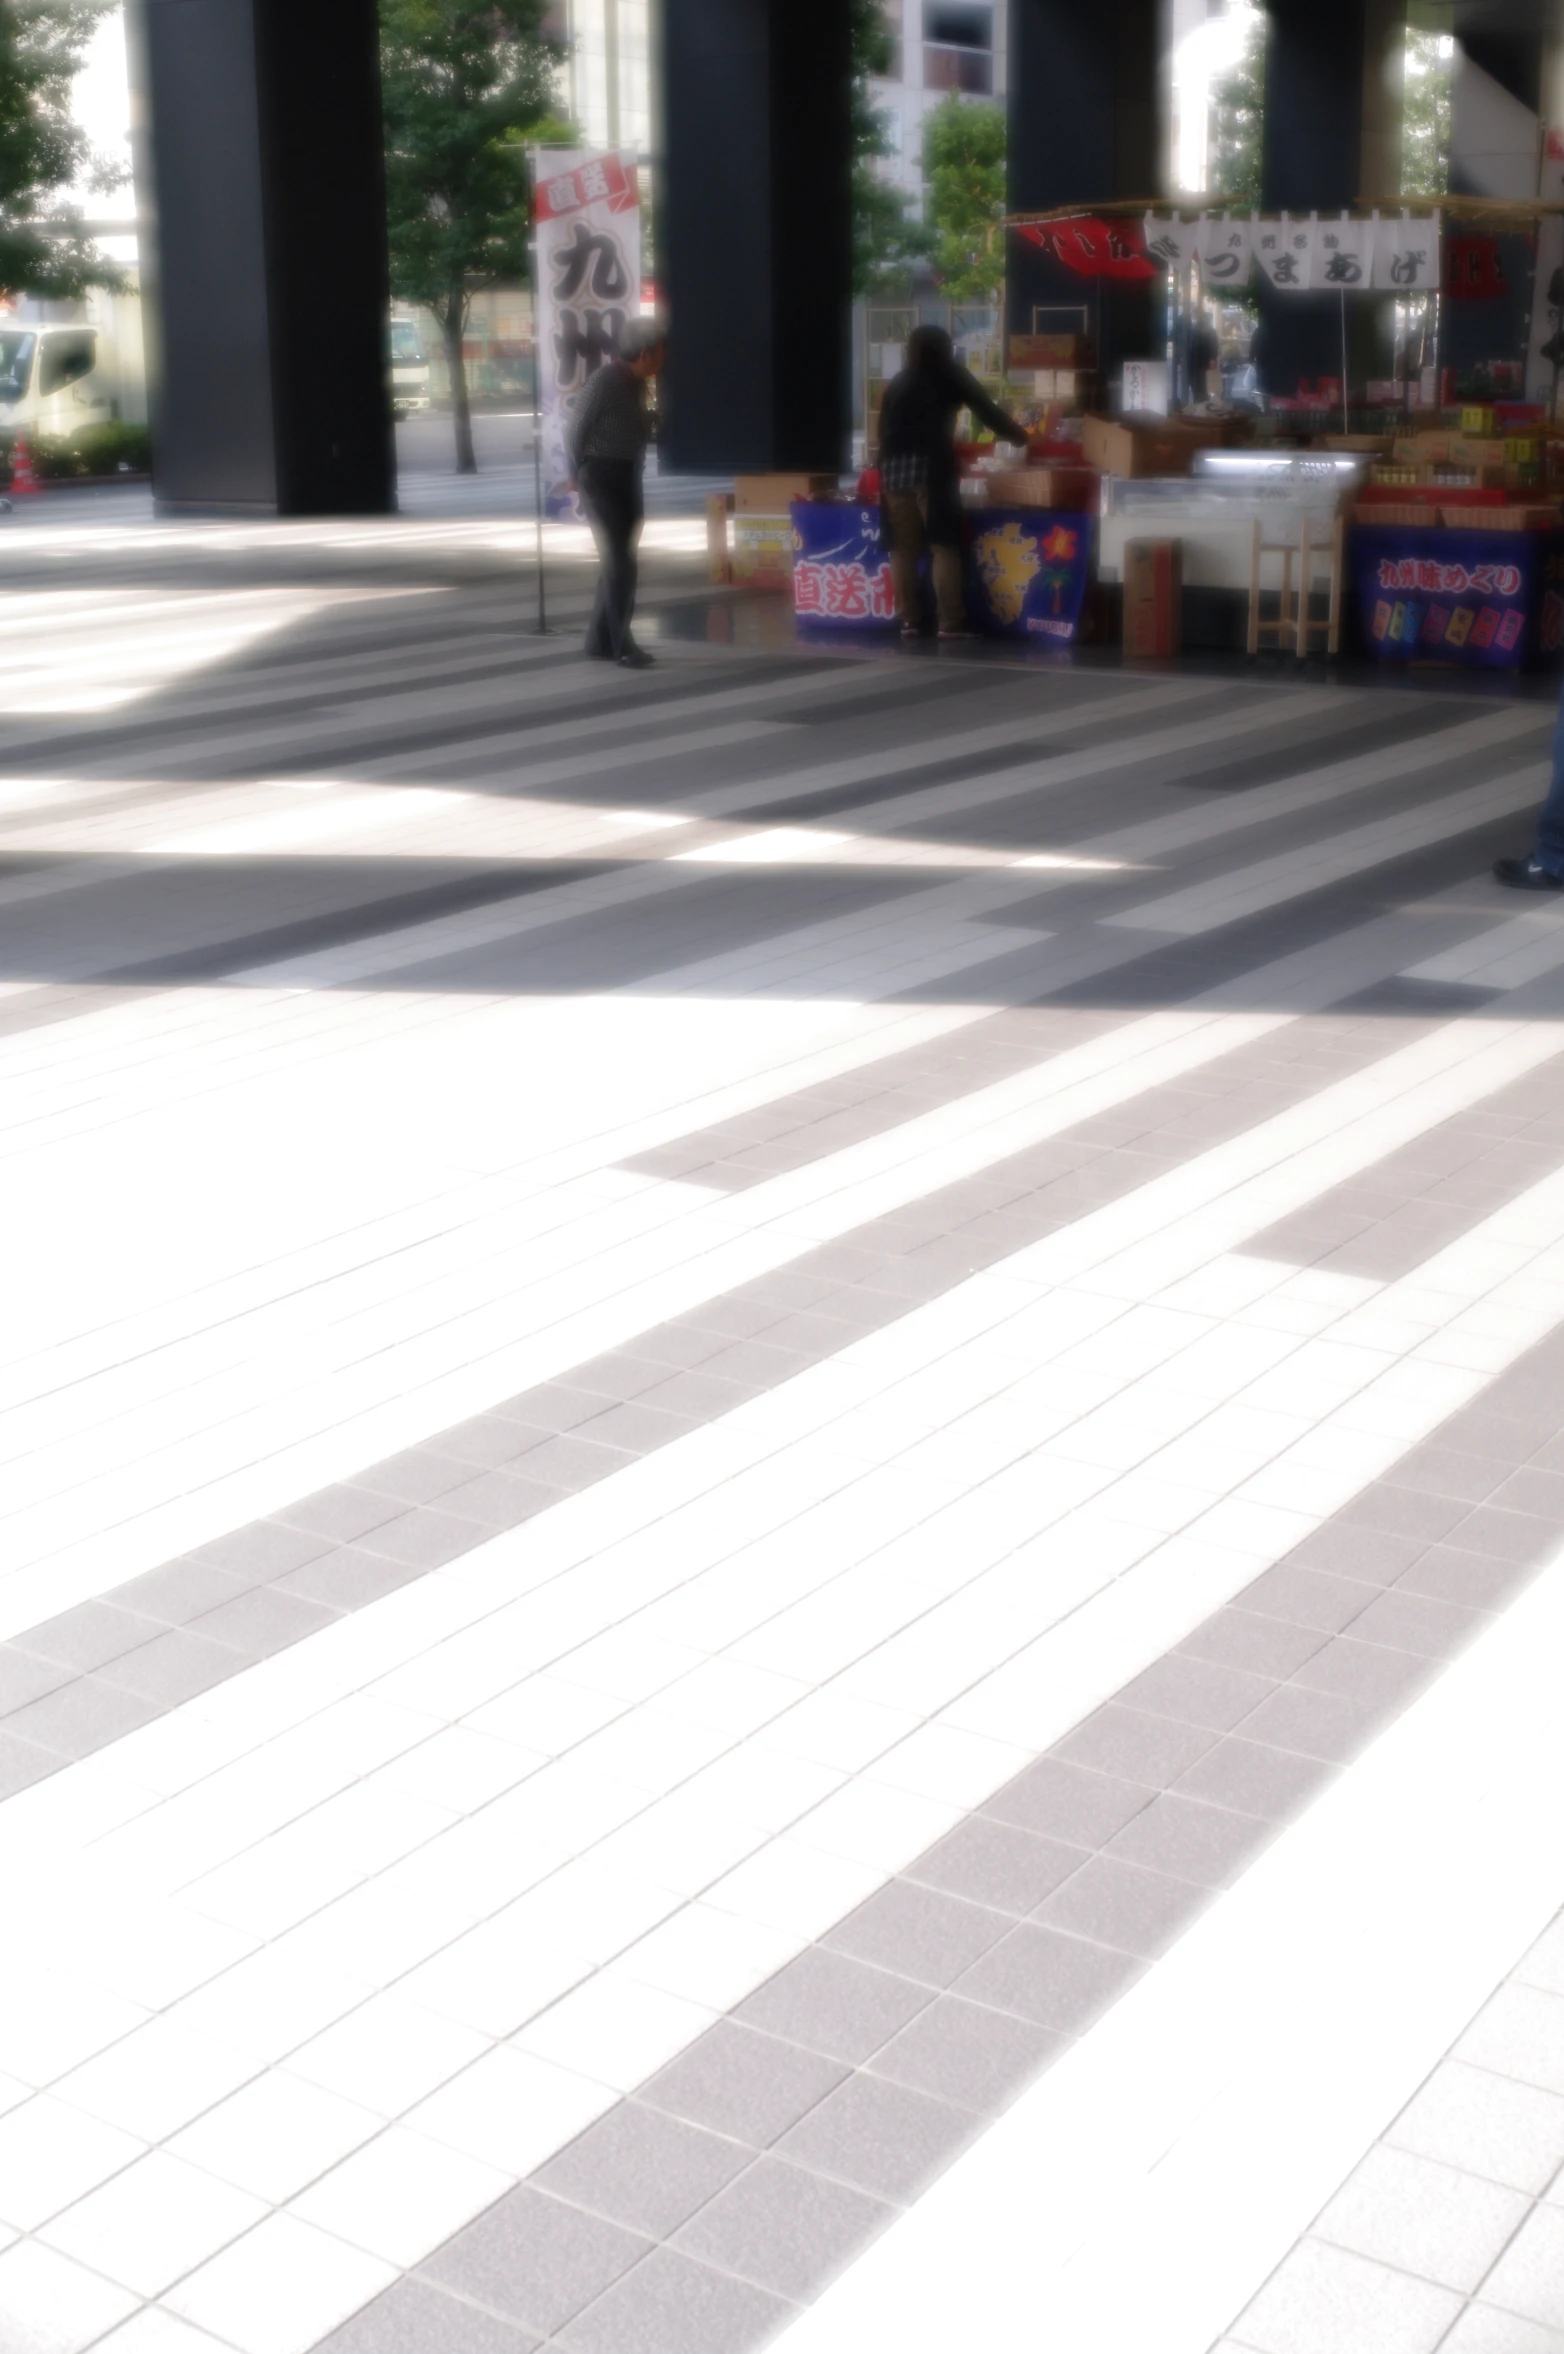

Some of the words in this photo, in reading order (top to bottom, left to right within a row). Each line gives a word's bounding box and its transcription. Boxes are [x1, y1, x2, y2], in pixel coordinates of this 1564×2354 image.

[1379, 559, 1521, 595] 九州味めぐり
